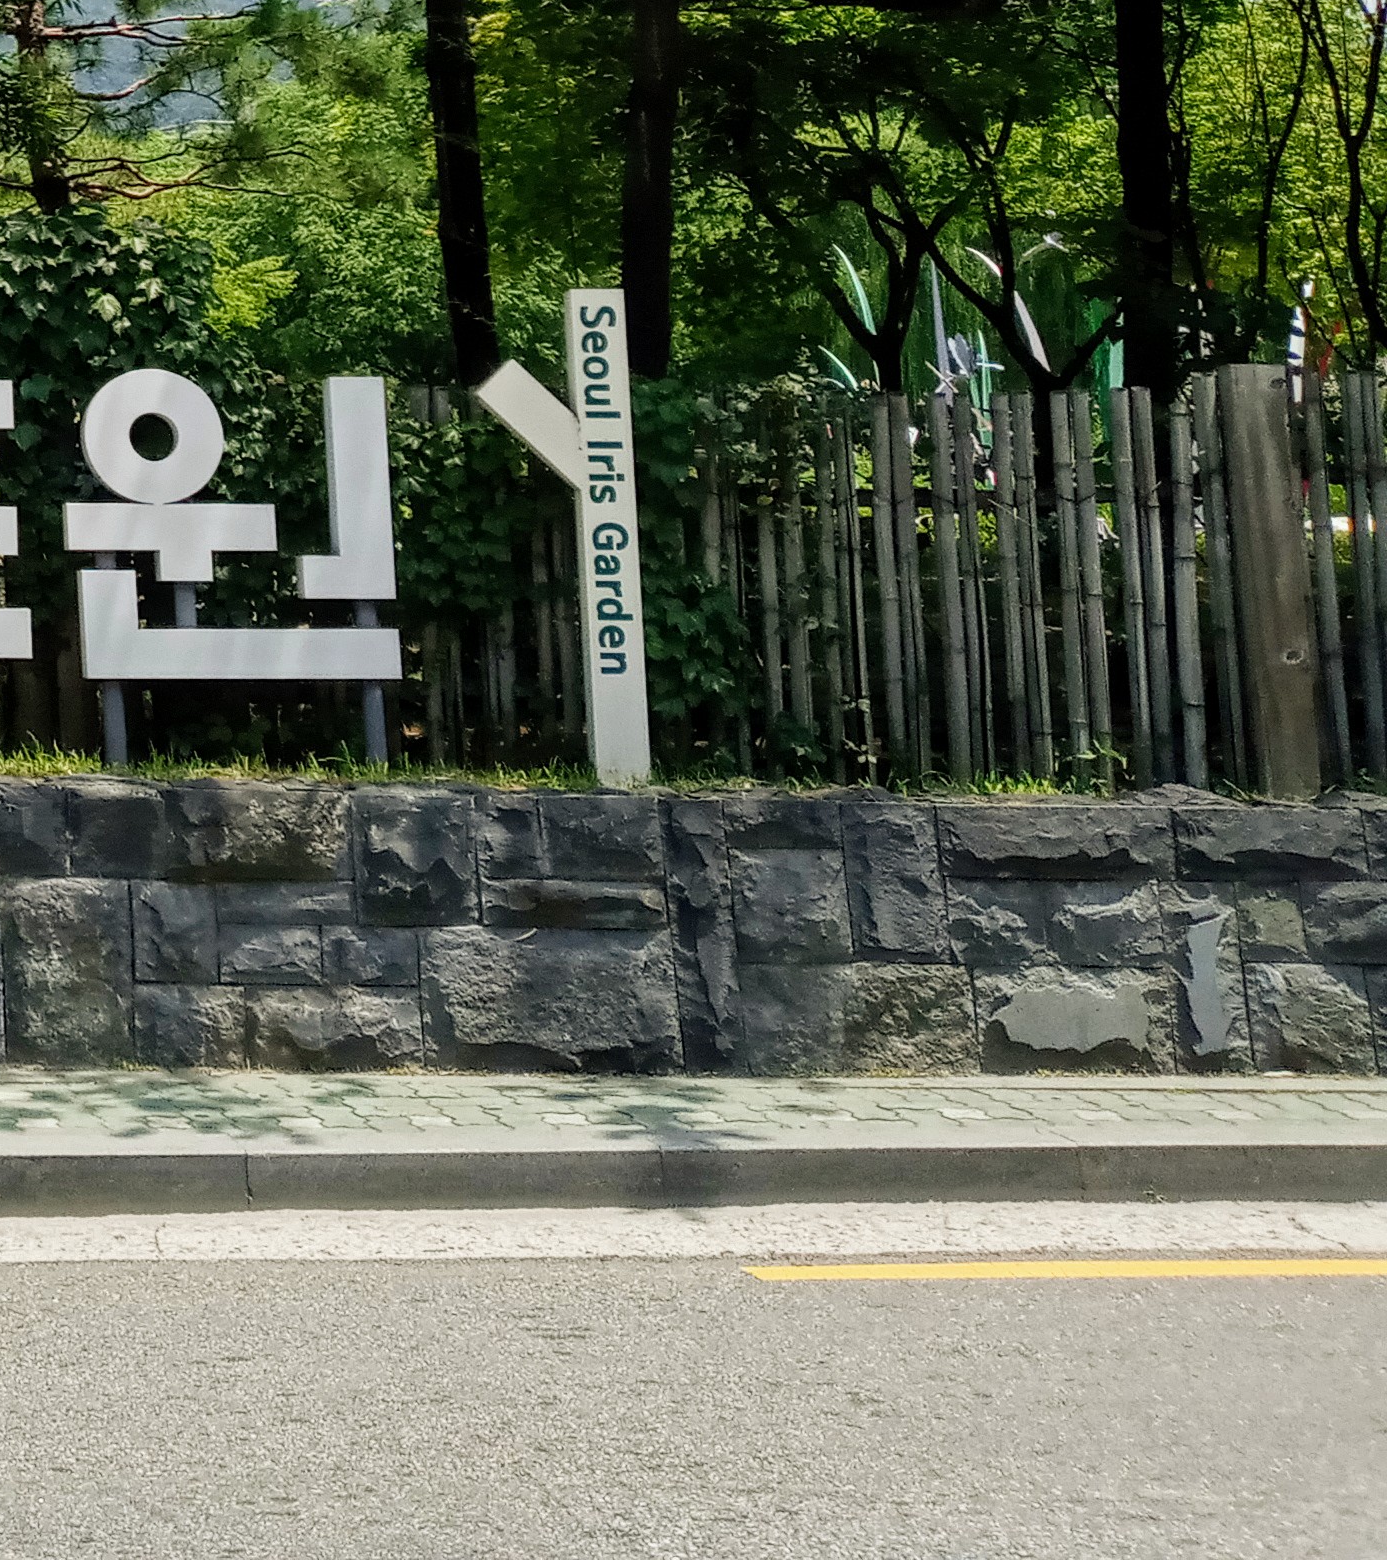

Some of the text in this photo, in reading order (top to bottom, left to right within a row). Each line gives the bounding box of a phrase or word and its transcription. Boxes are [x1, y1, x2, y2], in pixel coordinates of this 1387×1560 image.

[579, 305, 634, 675] Seoul Iris Garden
